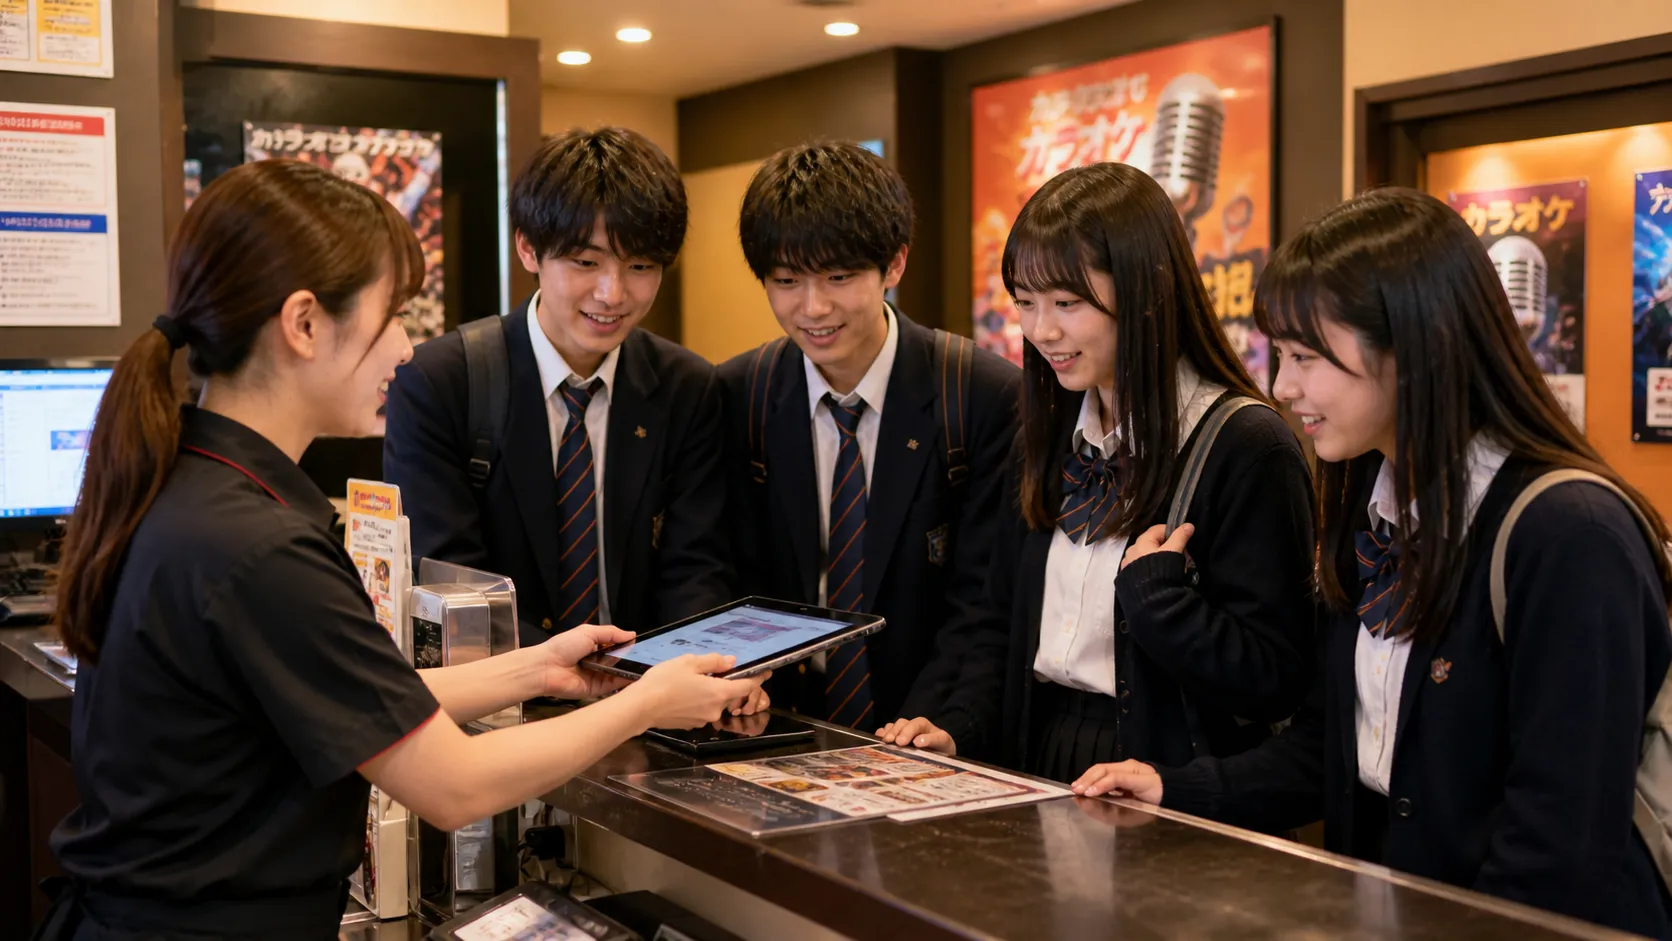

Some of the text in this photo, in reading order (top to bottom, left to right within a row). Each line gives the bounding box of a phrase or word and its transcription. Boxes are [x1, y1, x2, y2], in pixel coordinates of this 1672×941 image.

[1016, 110, 1146, 180] カラオケ
[1461, 194, 1575, 237] カラオケ
